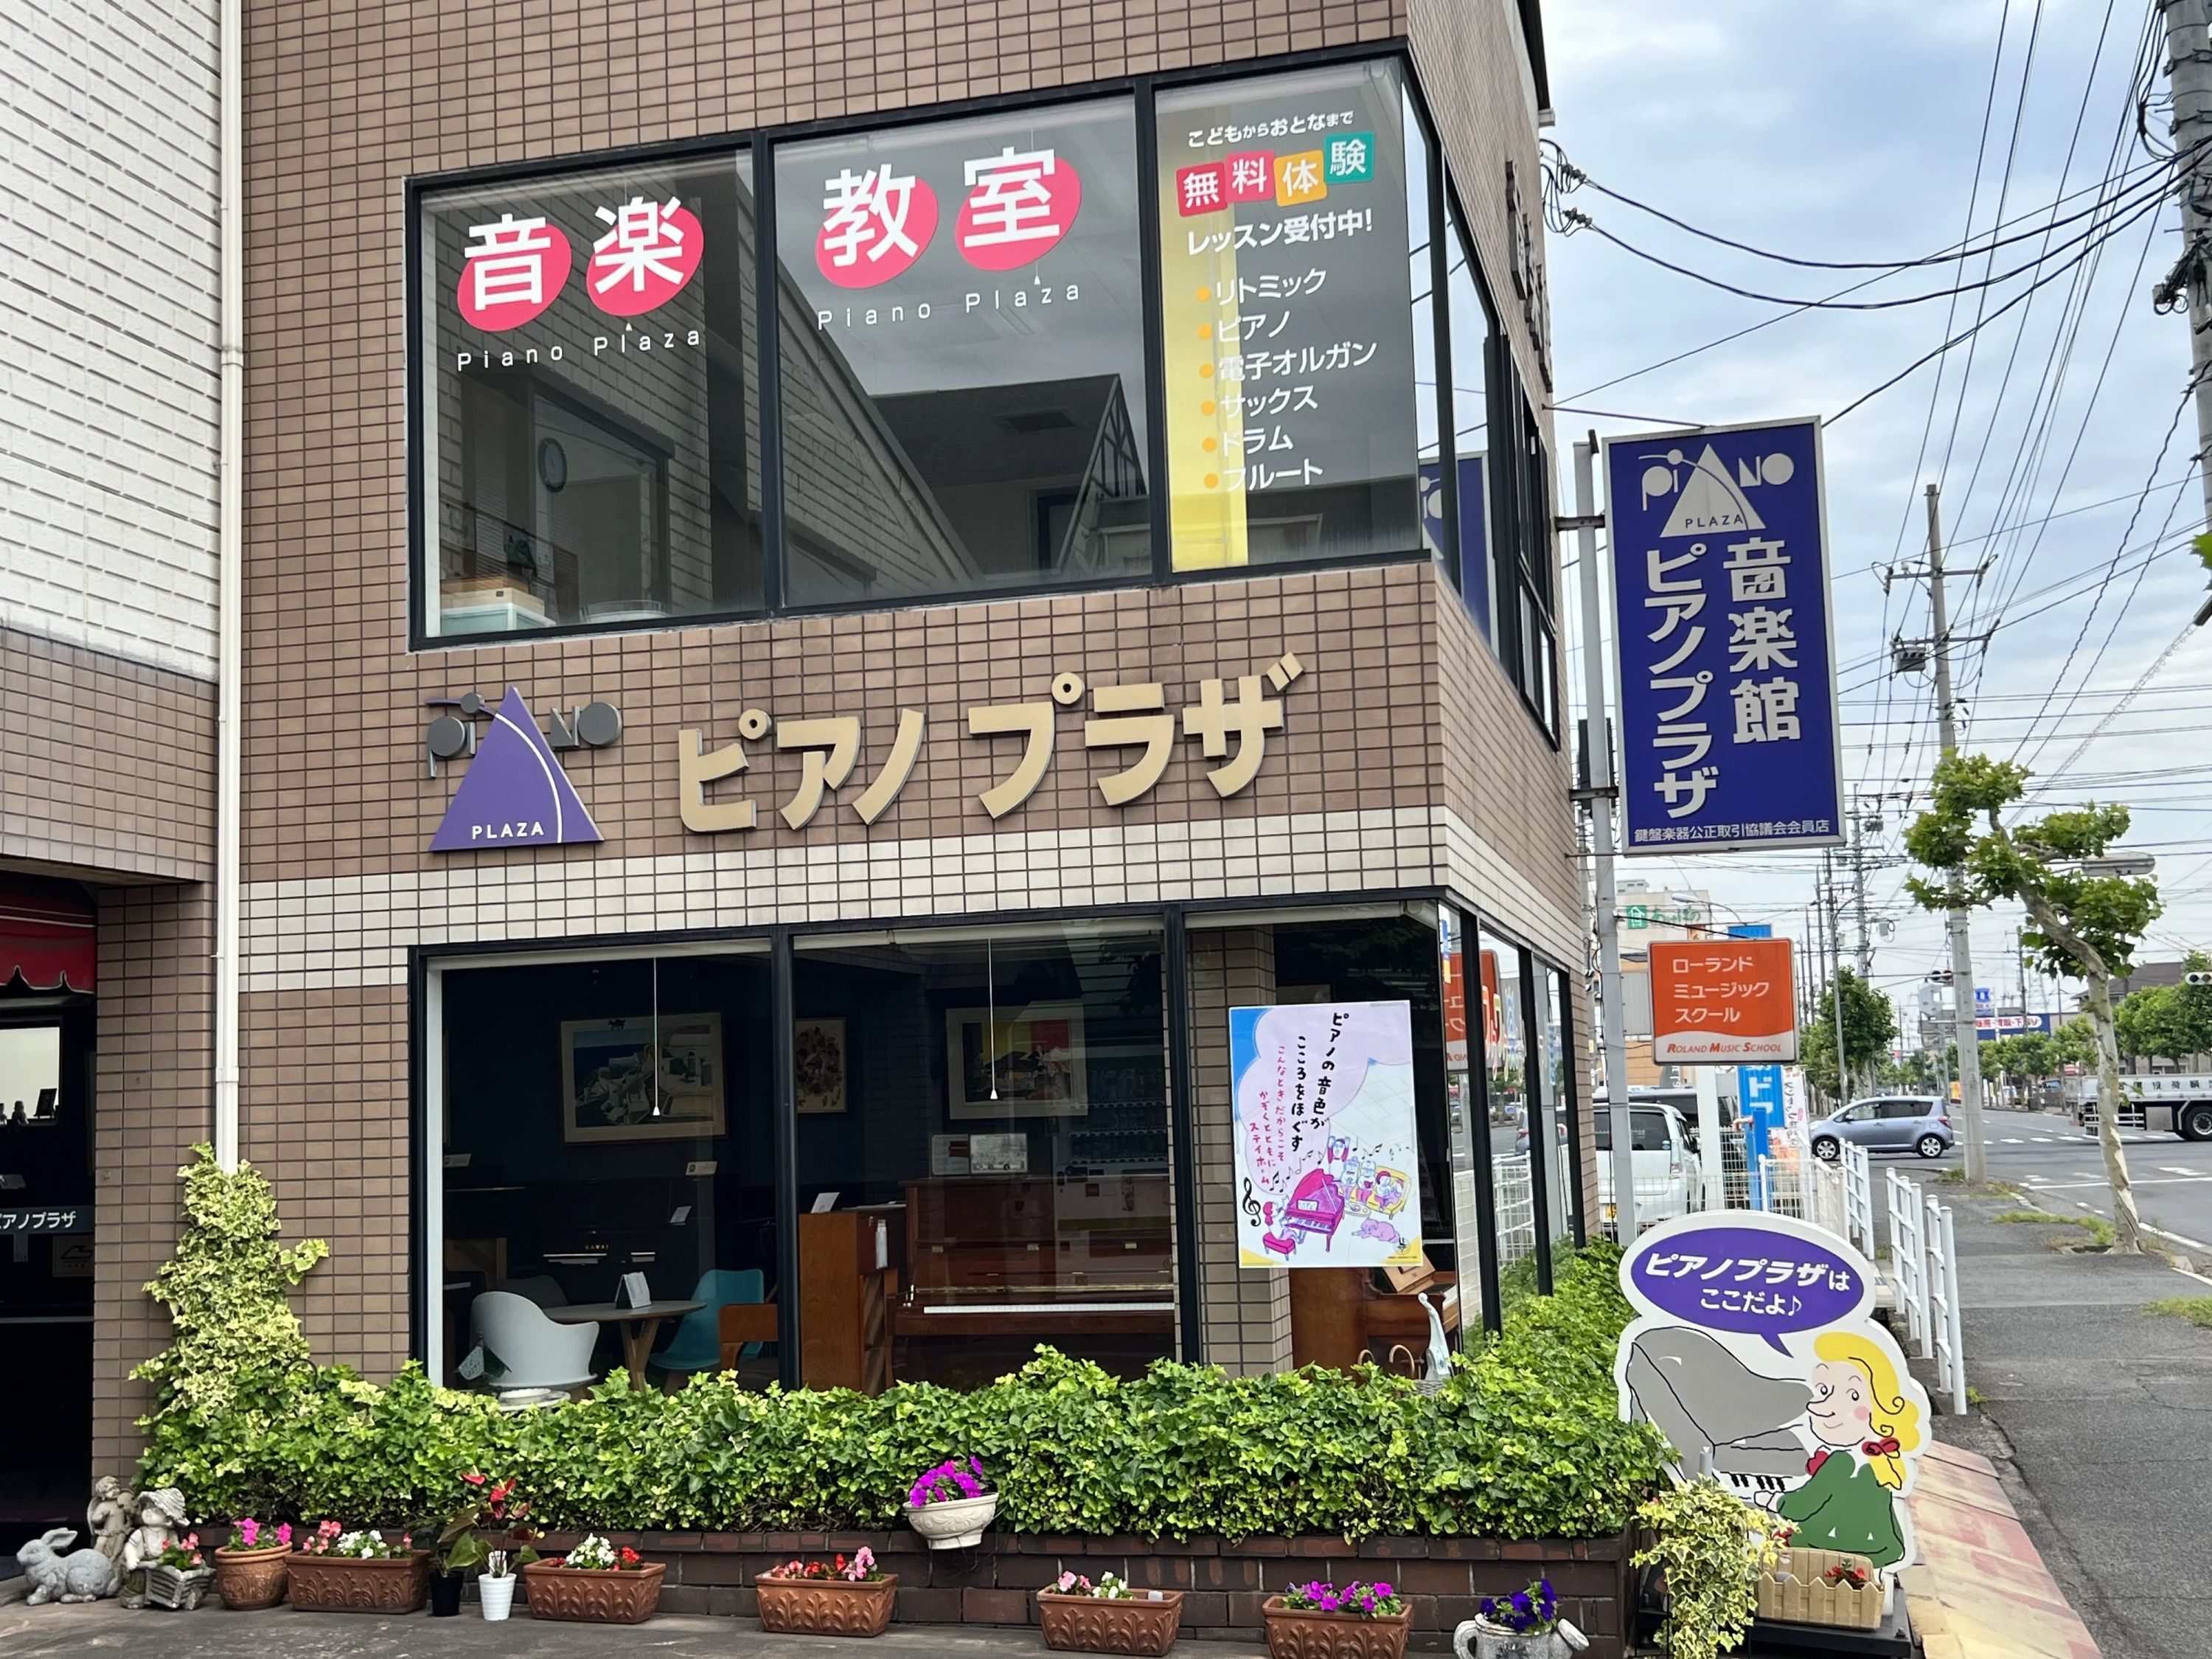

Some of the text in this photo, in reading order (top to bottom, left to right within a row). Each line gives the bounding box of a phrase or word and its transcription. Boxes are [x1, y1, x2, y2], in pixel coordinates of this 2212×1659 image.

[1188, 111, 1354, 147] こどもからおとなまで
[1183, 139, 1366, 209] 無料体験
[1188, 208, 1373, 255] レッスン受付中!
[1217, 268, 1326, 305] リトミック
[818, 284, 1079, 330] Piano Plaza
[1218, 310, 1291, 343] ピアノ
[457, 330, 700, 372] Piano Plaza
[1218, 342, 1377, 381] 電子オルガン
[1220, 385, 1319, 418] サックス
[1222, 424, 1294, 456] ドラム
[1222, 458, 1324, 492] フルート
[1685, 514, 1744, 529] PLAZA
[1722, 536, 1801, 744] 音楽館
[1644, 542, 1719, 819] ピアノプラザ
[679, 652, 1304, 832] ピアノプラザ
[472, 821, 545, 841] PLAZA
[1672, 956, 1753, 973] ローランド
[1673, 981, 1770, 999] ミュージック
[1674, 1007, 1741, 1023] スクール
[1310, 1012, 1350, 1130] ピアノの音色が
[1275, 1046, 1287, 1161] こんなときだからこそ
[1291, 1035, 1308, 1152] こころをほぐす
[1259, 1091, 1276, 1167] かぞくとともに
[1250, 1122, 1270, 1184] ステイホーム
[1645, 1253, 1851, 1291] ピアノプラザは
